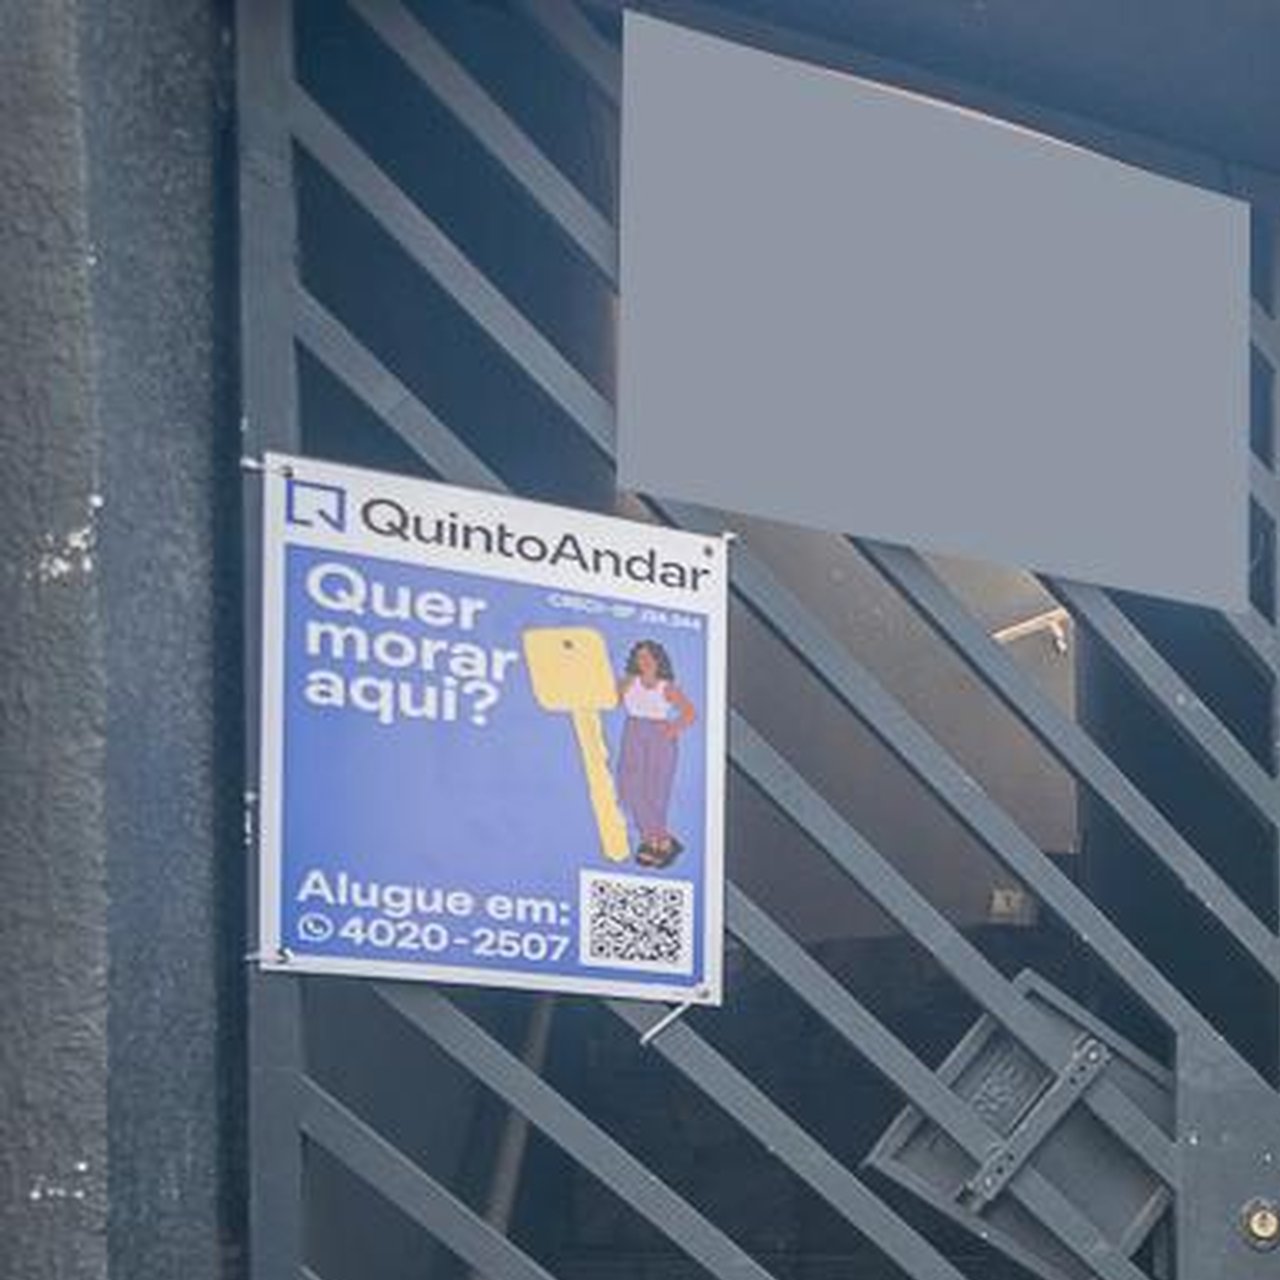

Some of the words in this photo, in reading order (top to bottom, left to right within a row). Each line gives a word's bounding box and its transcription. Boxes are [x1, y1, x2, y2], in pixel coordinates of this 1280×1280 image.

[360, 498, 711, 592] QuintoAndar
[306, 562, 488, 631] Quer
[305, 619, 520, 683] morar
[303, 668, 500, 727] aqui?
[296, 868, 475, 919] Alugue
[486, 893, 572, 927] em:
[339, 915, 572, 962] 4020-2507
